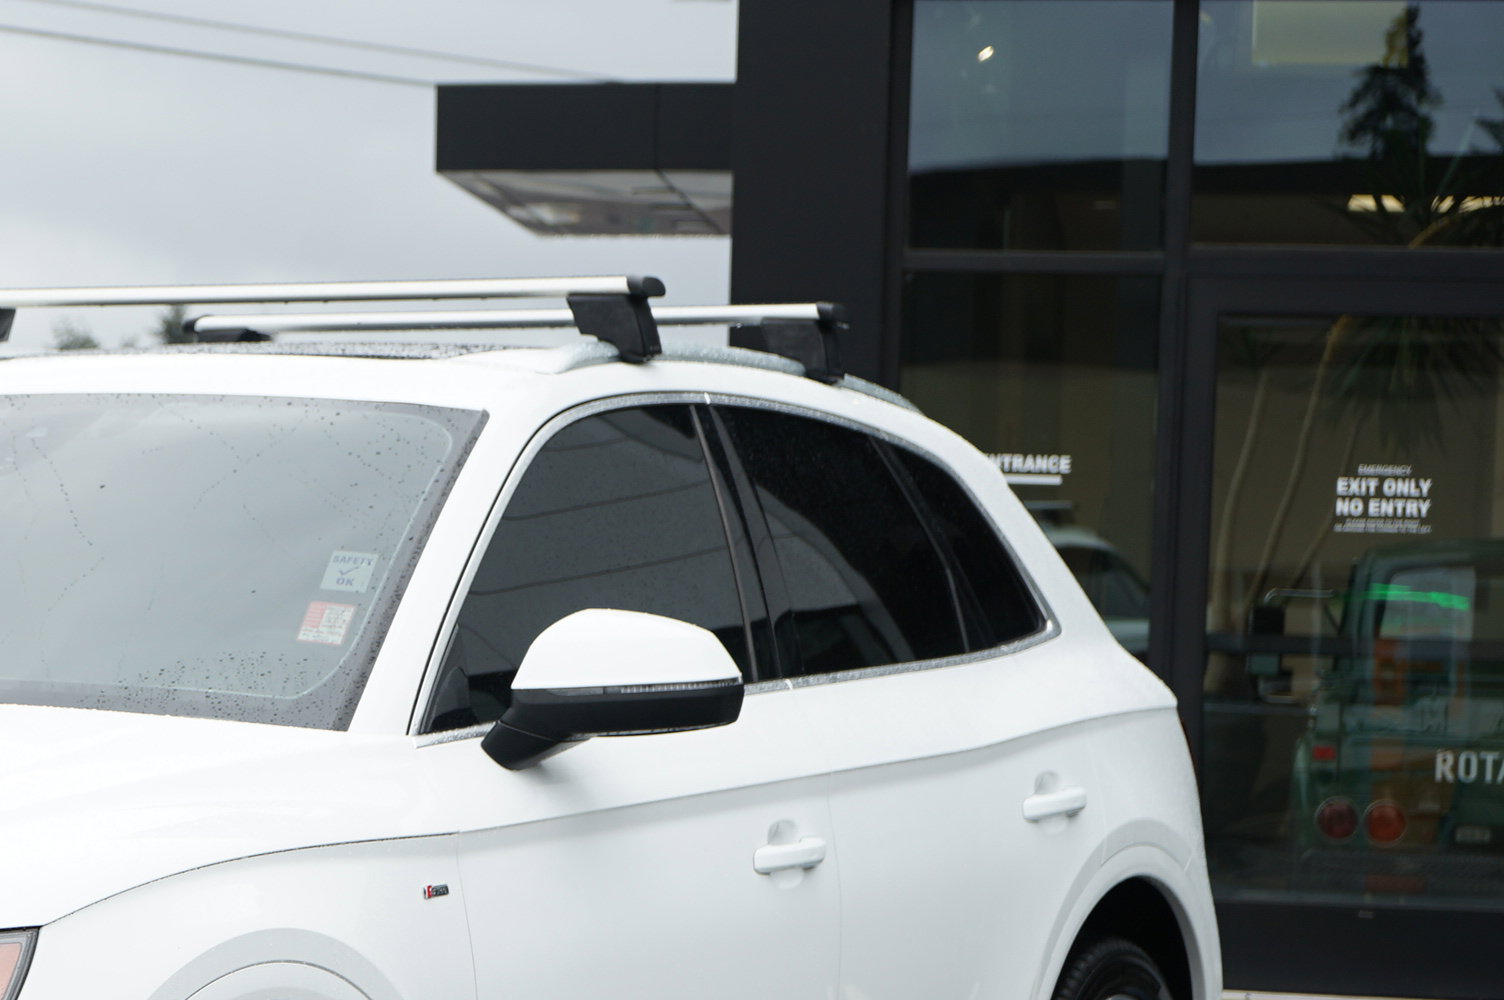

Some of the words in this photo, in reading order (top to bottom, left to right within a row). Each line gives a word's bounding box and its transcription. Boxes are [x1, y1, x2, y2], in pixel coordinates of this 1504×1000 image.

[987, 453, 1072, 474] NTRANCE
[1358, 464, 1412, 475] EMERGENCY
[1336, 476, 1379, 497] EXIT
[1383, 477, 1432, 497] ONLY
[1335, 497, 1364, 517] NO
[1368, 498, 1432, 517] ENTRY
[333, 555, 373, 565] SAFETY
[336, 578, 354, 586] OK
